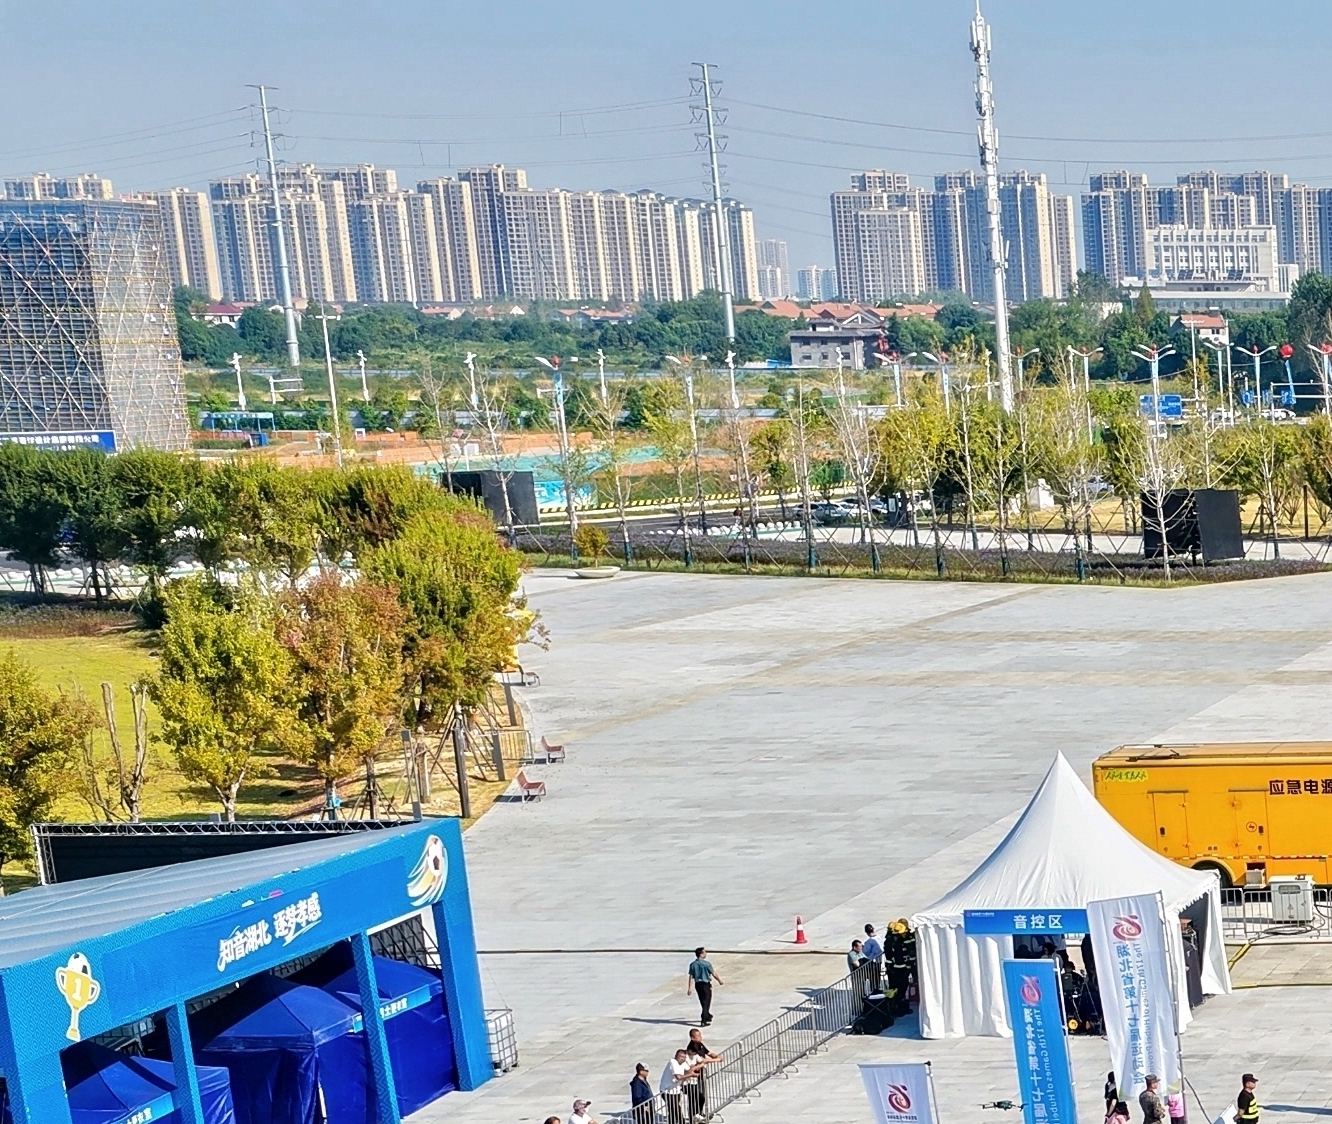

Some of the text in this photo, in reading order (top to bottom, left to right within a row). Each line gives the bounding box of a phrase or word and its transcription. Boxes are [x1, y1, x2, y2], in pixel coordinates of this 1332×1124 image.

[1013, 914, 1063, 930] 音控区
[217, 919, 273, 973] 知音湖北
